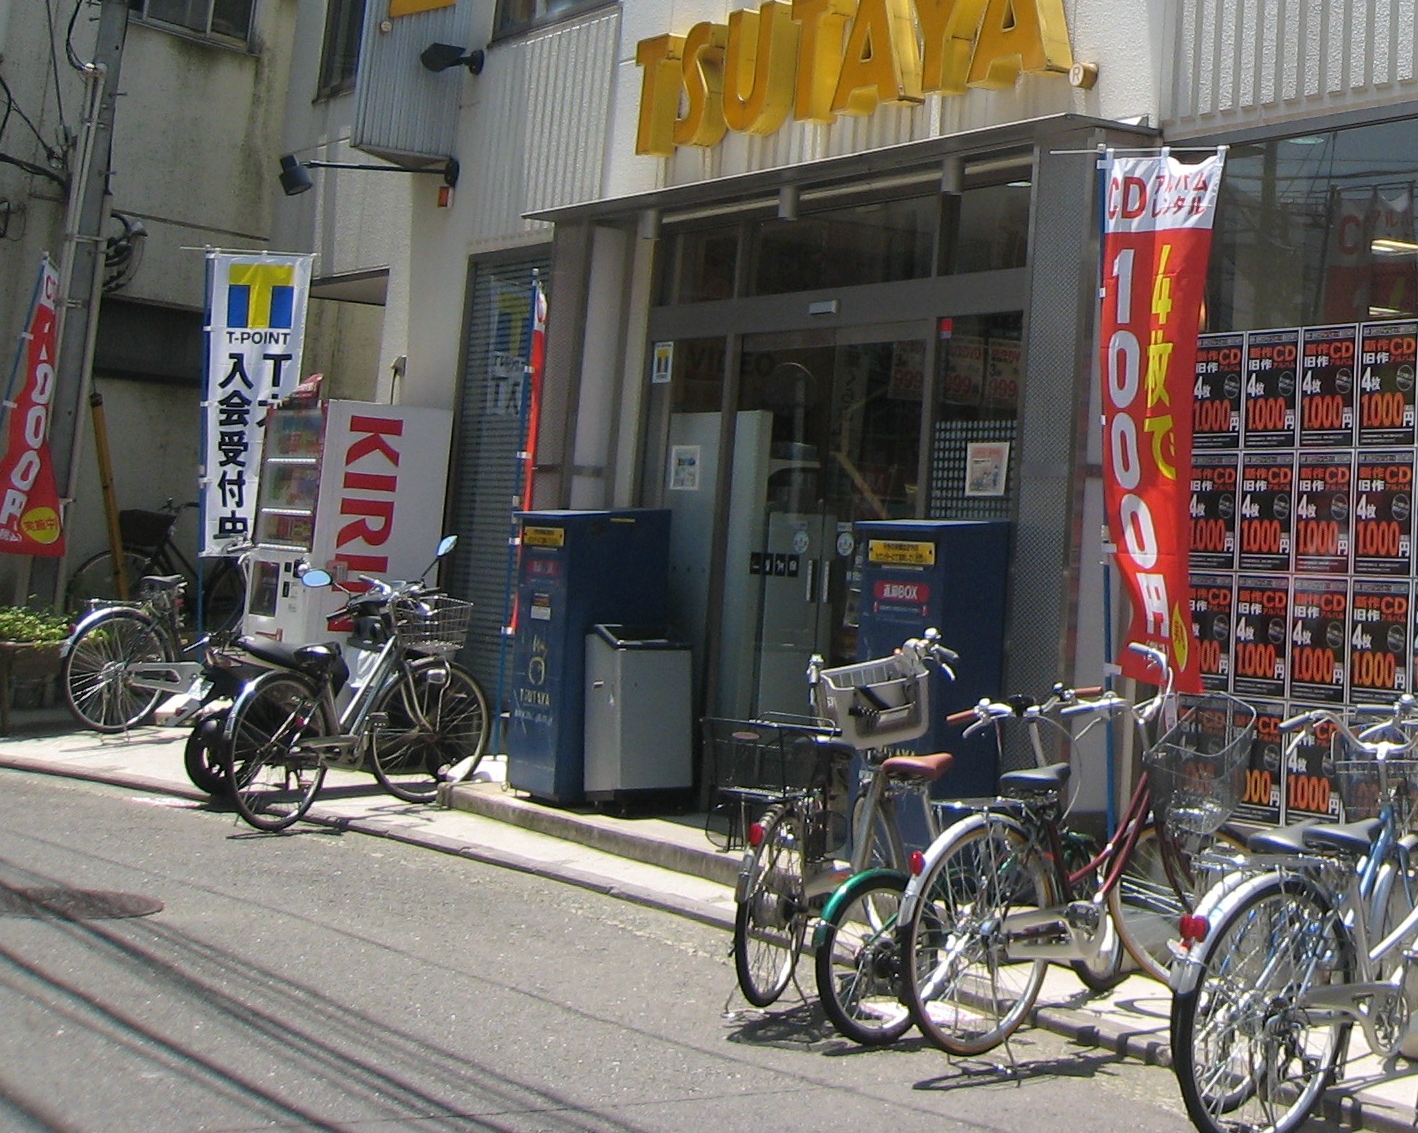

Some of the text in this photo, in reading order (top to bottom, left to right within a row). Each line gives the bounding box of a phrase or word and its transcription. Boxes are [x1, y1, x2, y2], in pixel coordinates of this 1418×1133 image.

[1108, 176, 1147, 220] CD
[226, 331, 292, 346] T-POINT
[1389, 336, 1415, 355] CD
[1218, 348, 1240, 365] CD
[1272, 344, 1295, 362] CD
[1329, 340, 1354, 359] CD
[1267, 467, 1291, 483] CD
[1324, 466, 1349, 483] CD
[1385, 465, 1411, 483] CD
[1262, 590, 1286, 608] CD
[1320, 592, 1345, 611] CD
[1381, 595, 1407, 613] CD
